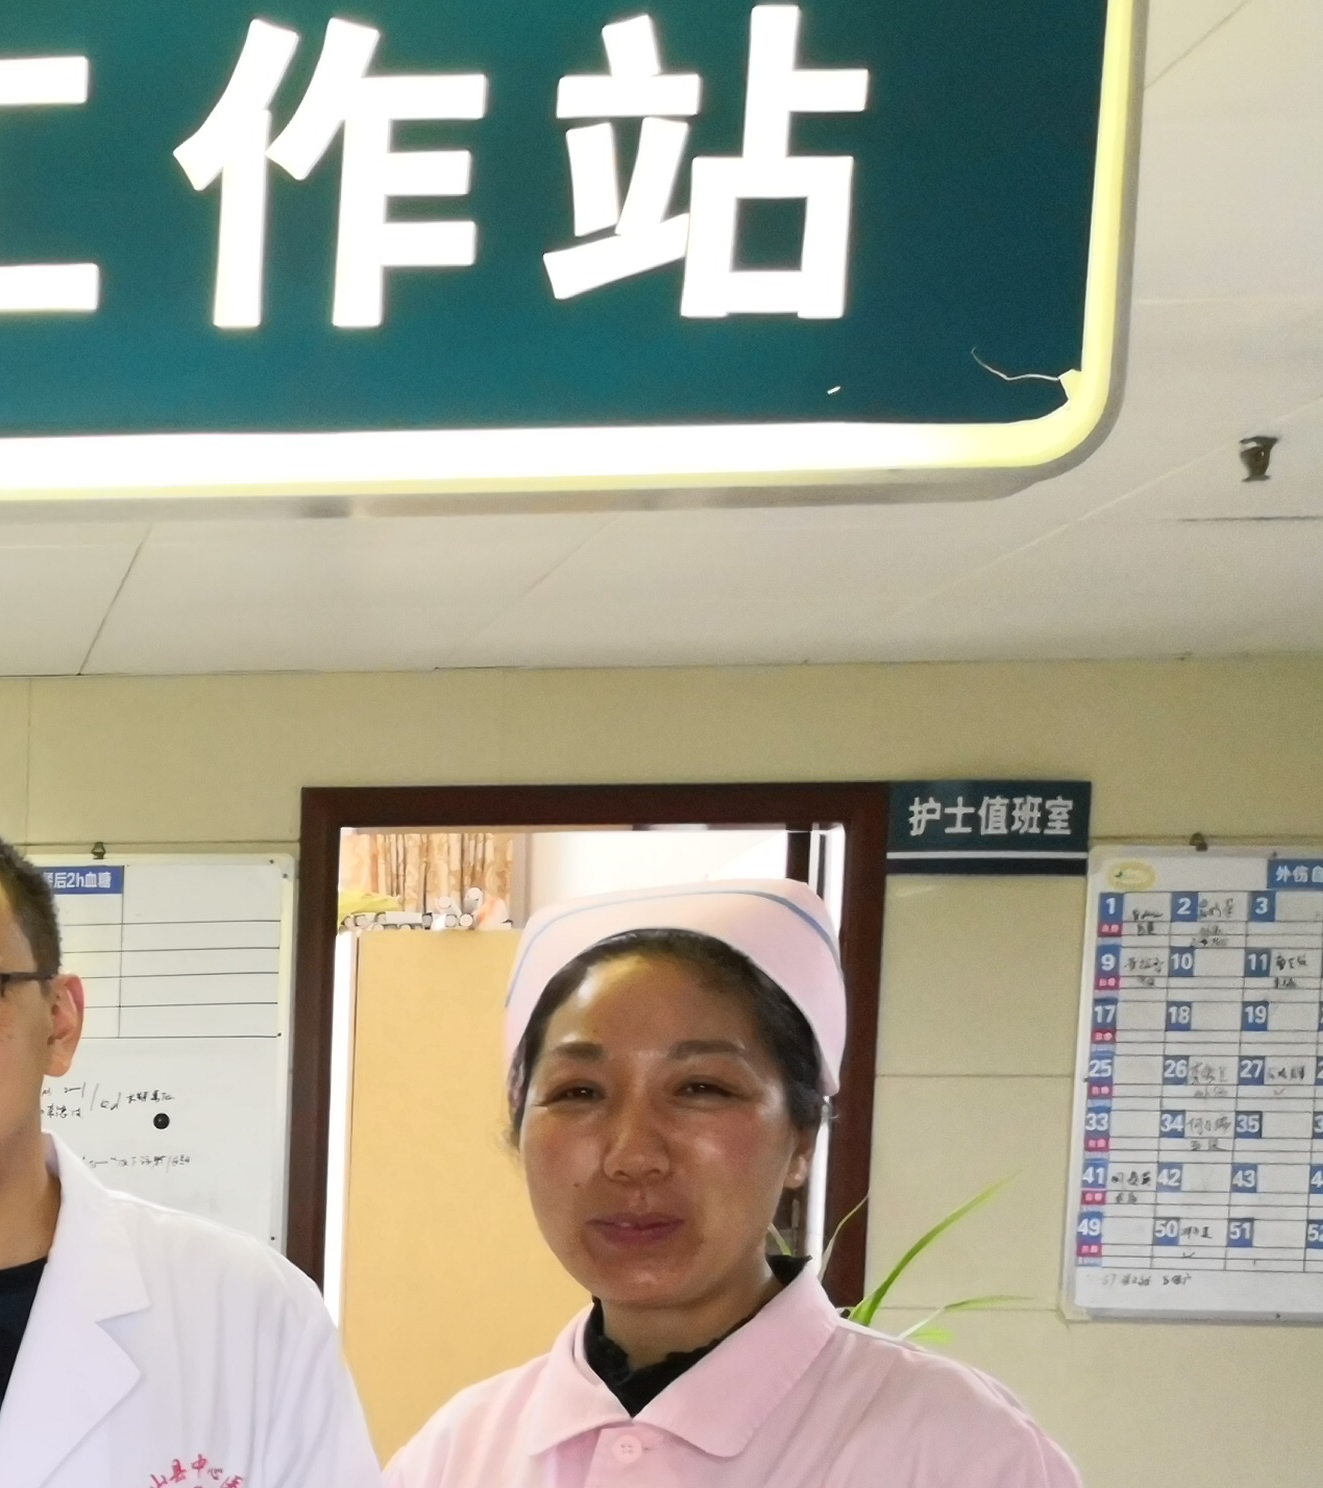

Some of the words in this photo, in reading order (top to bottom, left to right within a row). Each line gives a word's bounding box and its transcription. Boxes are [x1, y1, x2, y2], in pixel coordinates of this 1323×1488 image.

[909, 795, 1073, 836] 护士值班室
[1106, 898, 1115, 914] 1
[1177, 898, 1192, 915] 2
[1255, 897, 1268, 914] 3
[1101, 954, 1115, 971] 9
[1171, 953, 1193, 970] 10
[1248, 953, 1267, 971] 11
[1094, 1005, 1116, 1023] 17
[1168, 1006, 1190, 1024] 18
[1245, 1006, 1267, 1023] 19
[1089, 1060, 1112, 1077] 25
[1164, 1060, 1187, 1078] 26
[1240, 1060, 1263, 1077] 27
[1086, 1114, 1108, 1131] 33
[1160, 1114, 1184, 1132] 34
[1236, 1115, 1259, 1132] 35
[1082, 1167, 1104, 1184] 41
[1158, 1168, 1181, 1186] 42
[1232, 1169, 1255, 1187] 43
[1077, 1218, 1100, 1236] 49
[1155, 1221, 1178, 1238] 50
[1230, 1220, 1251, 1238] 51
